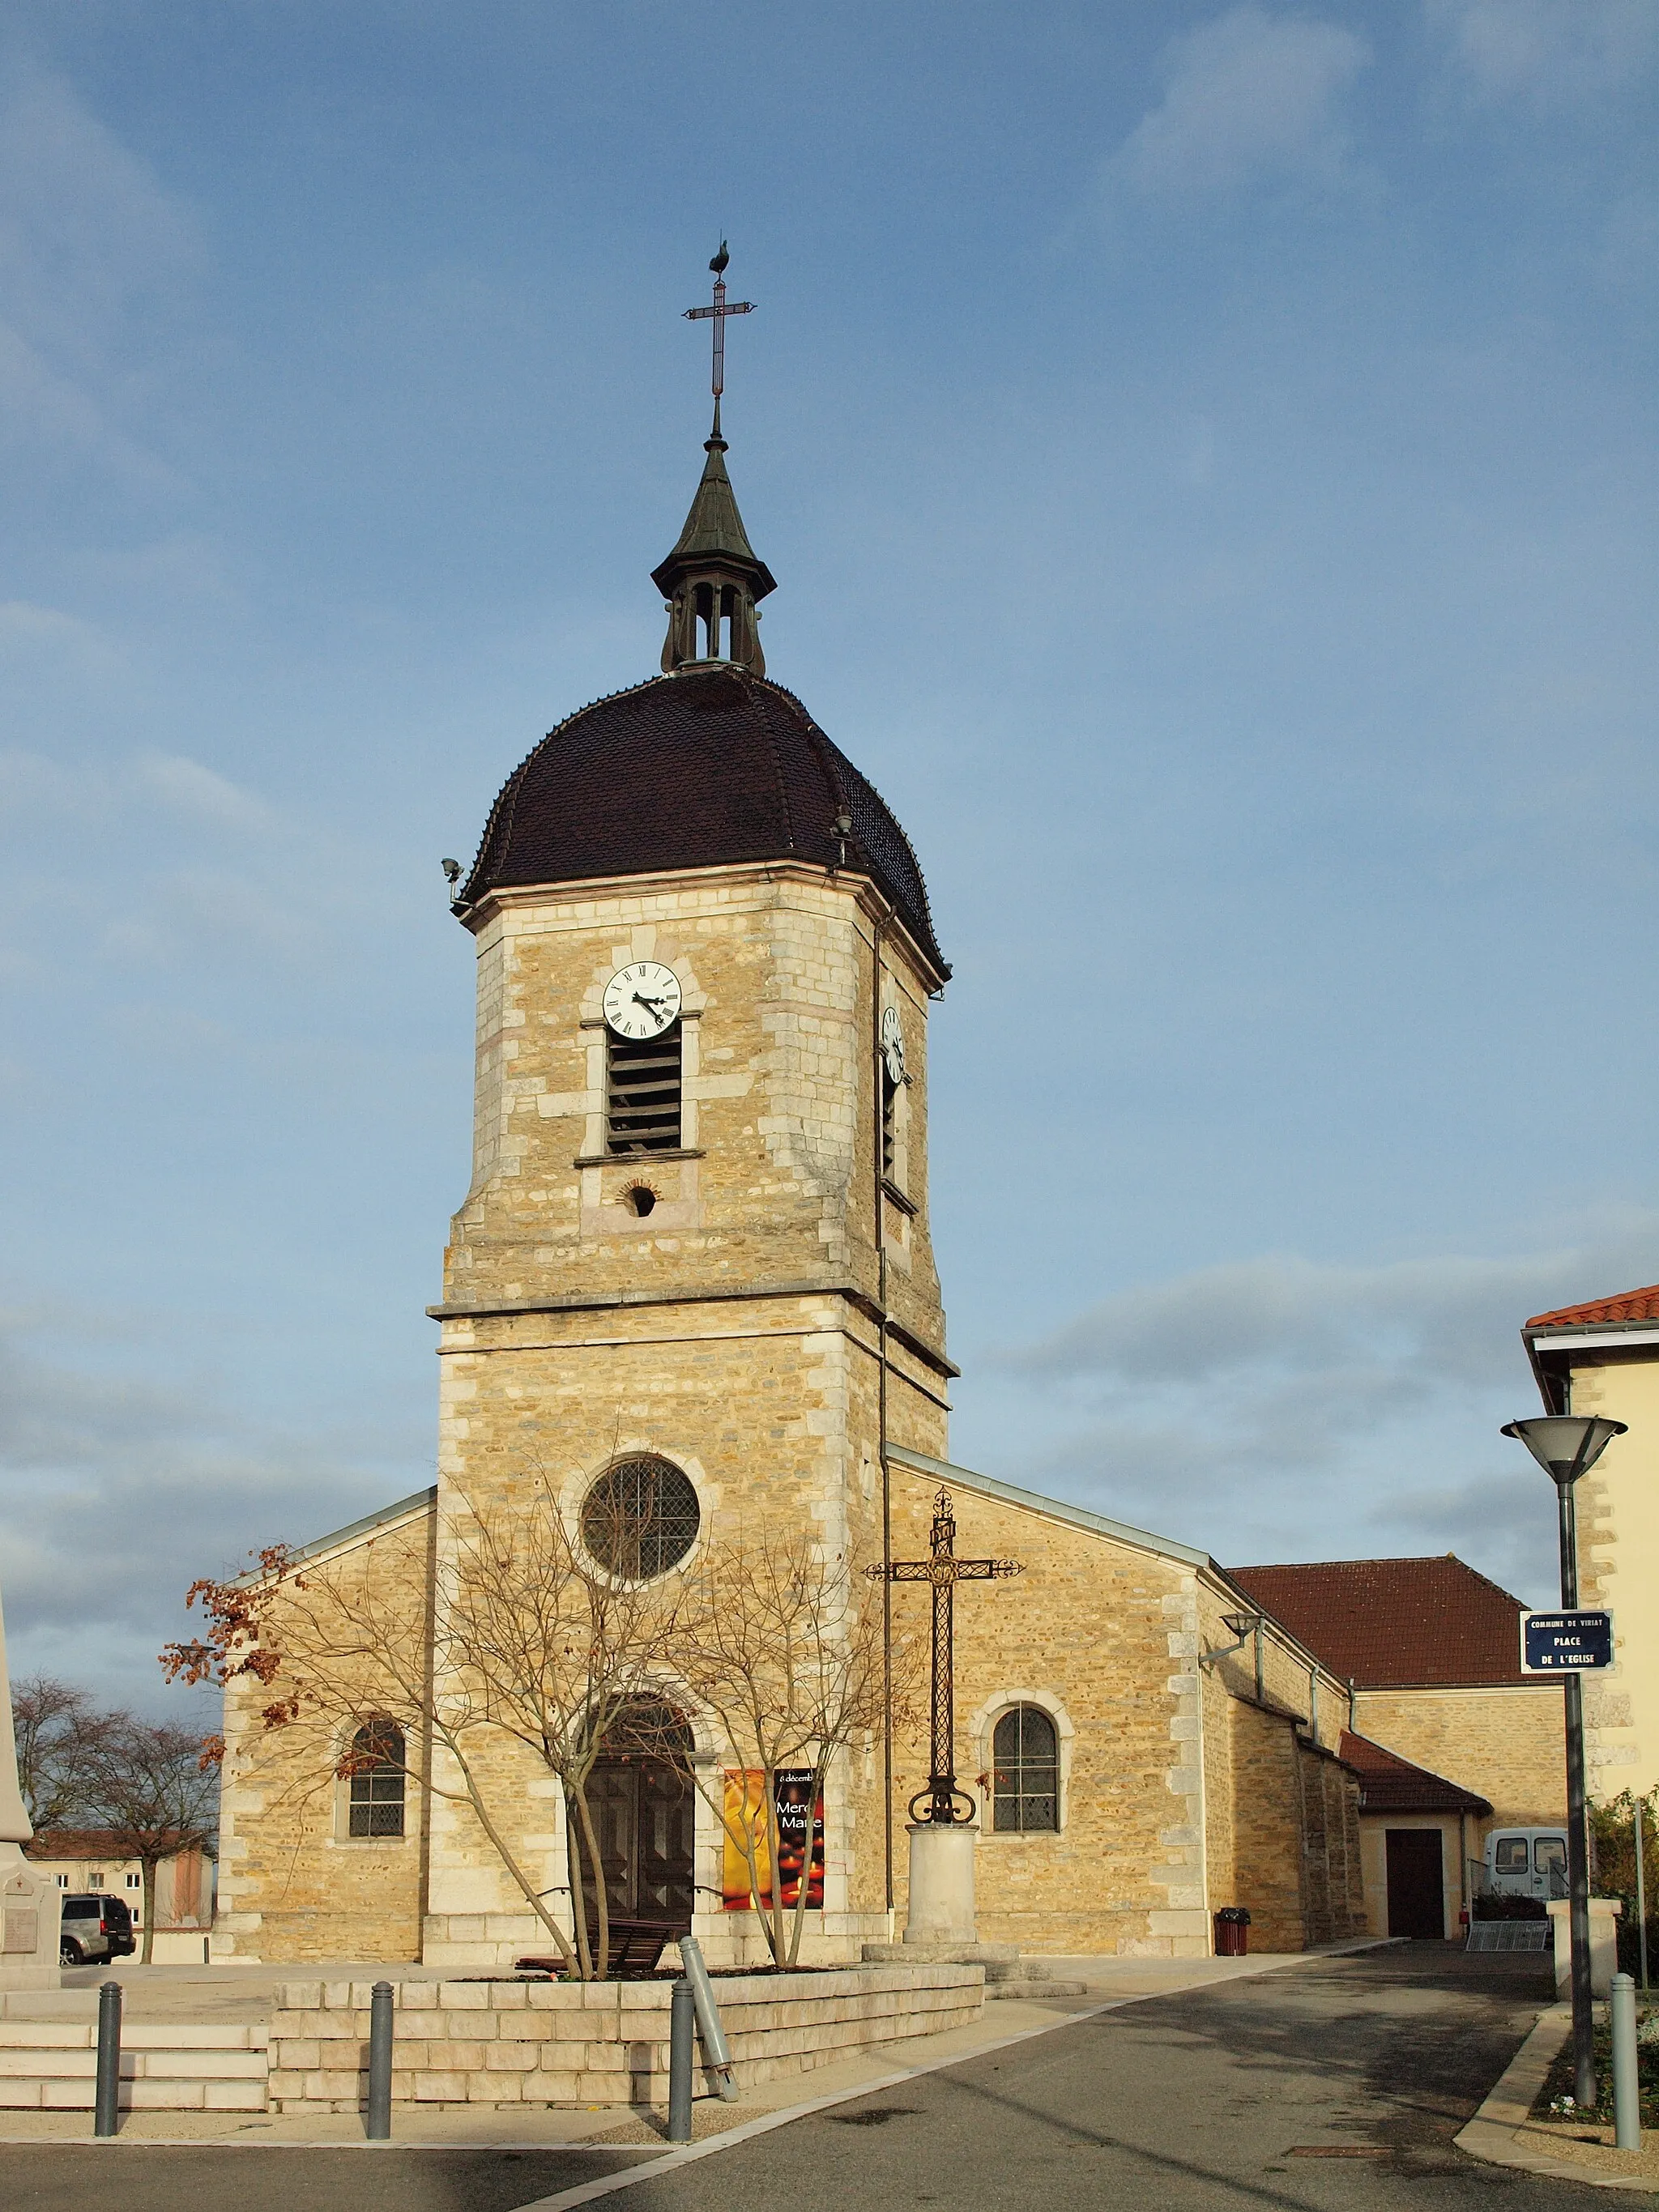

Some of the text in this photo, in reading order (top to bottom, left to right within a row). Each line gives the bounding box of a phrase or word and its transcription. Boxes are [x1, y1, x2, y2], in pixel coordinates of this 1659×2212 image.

[1531, 1621, 1564, 1629] COMMUNE
[1554, 1637, 1580, 1646] PLACE
[1542, 1655, 1594, 1664] DE L'EGLISE
[785, 1773, 813, 1783] décemb
[776, 1802, 808, 1813] Merc
[782, 1817, 822, 1828] Mare
